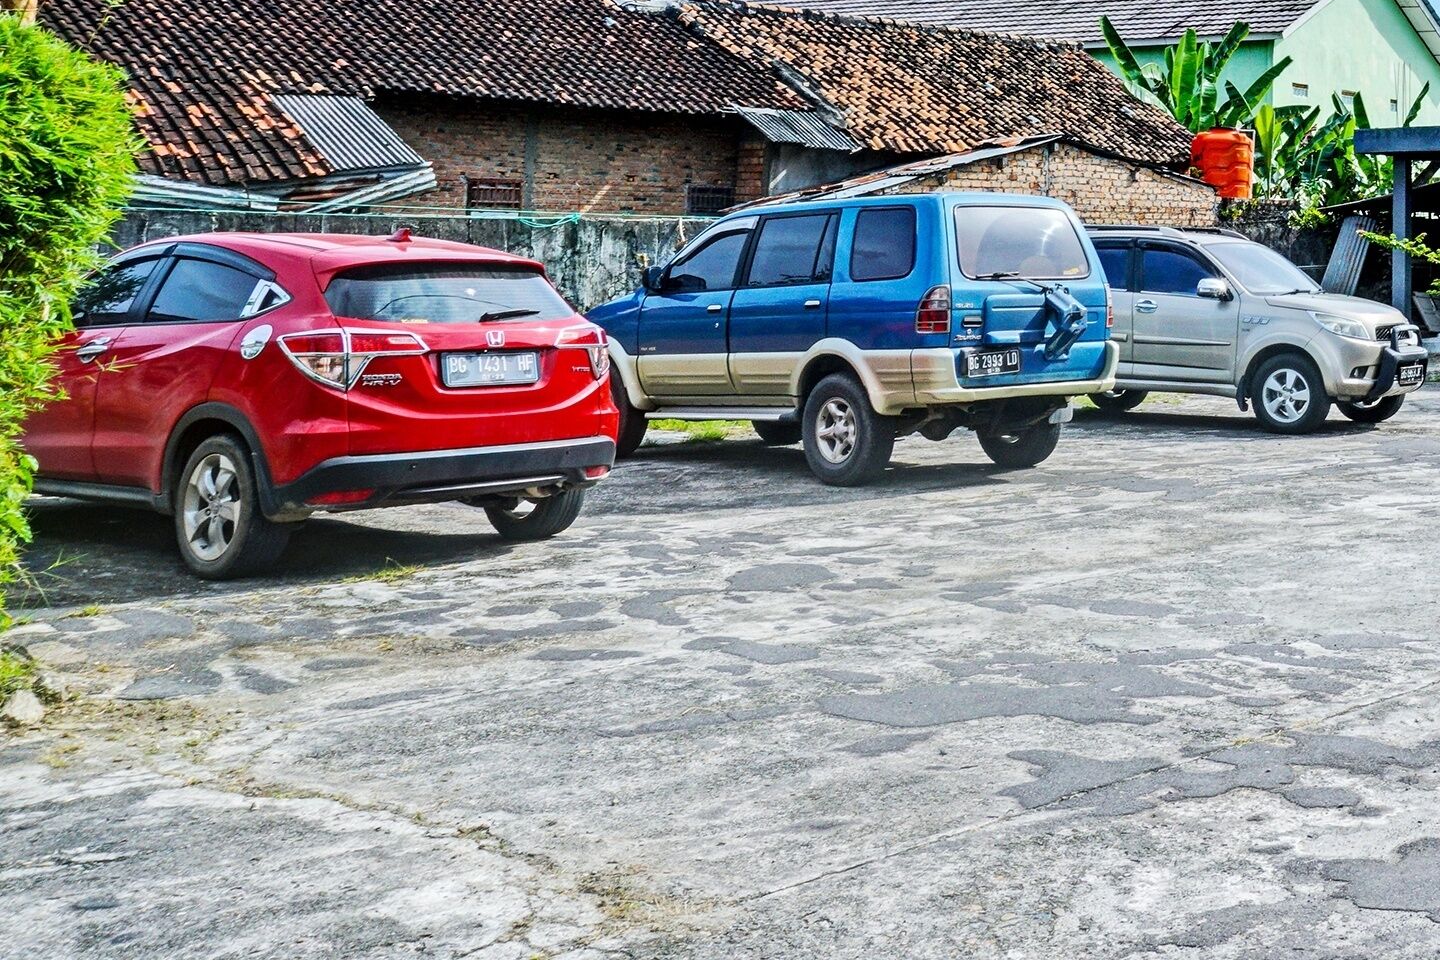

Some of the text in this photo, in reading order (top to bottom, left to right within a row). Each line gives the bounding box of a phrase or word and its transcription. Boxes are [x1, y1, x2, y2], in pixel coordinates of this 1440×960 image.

[448, 355, 533, 373] BG 1431 HF
[969, 351, 1017, 370] BG 2993 LD
